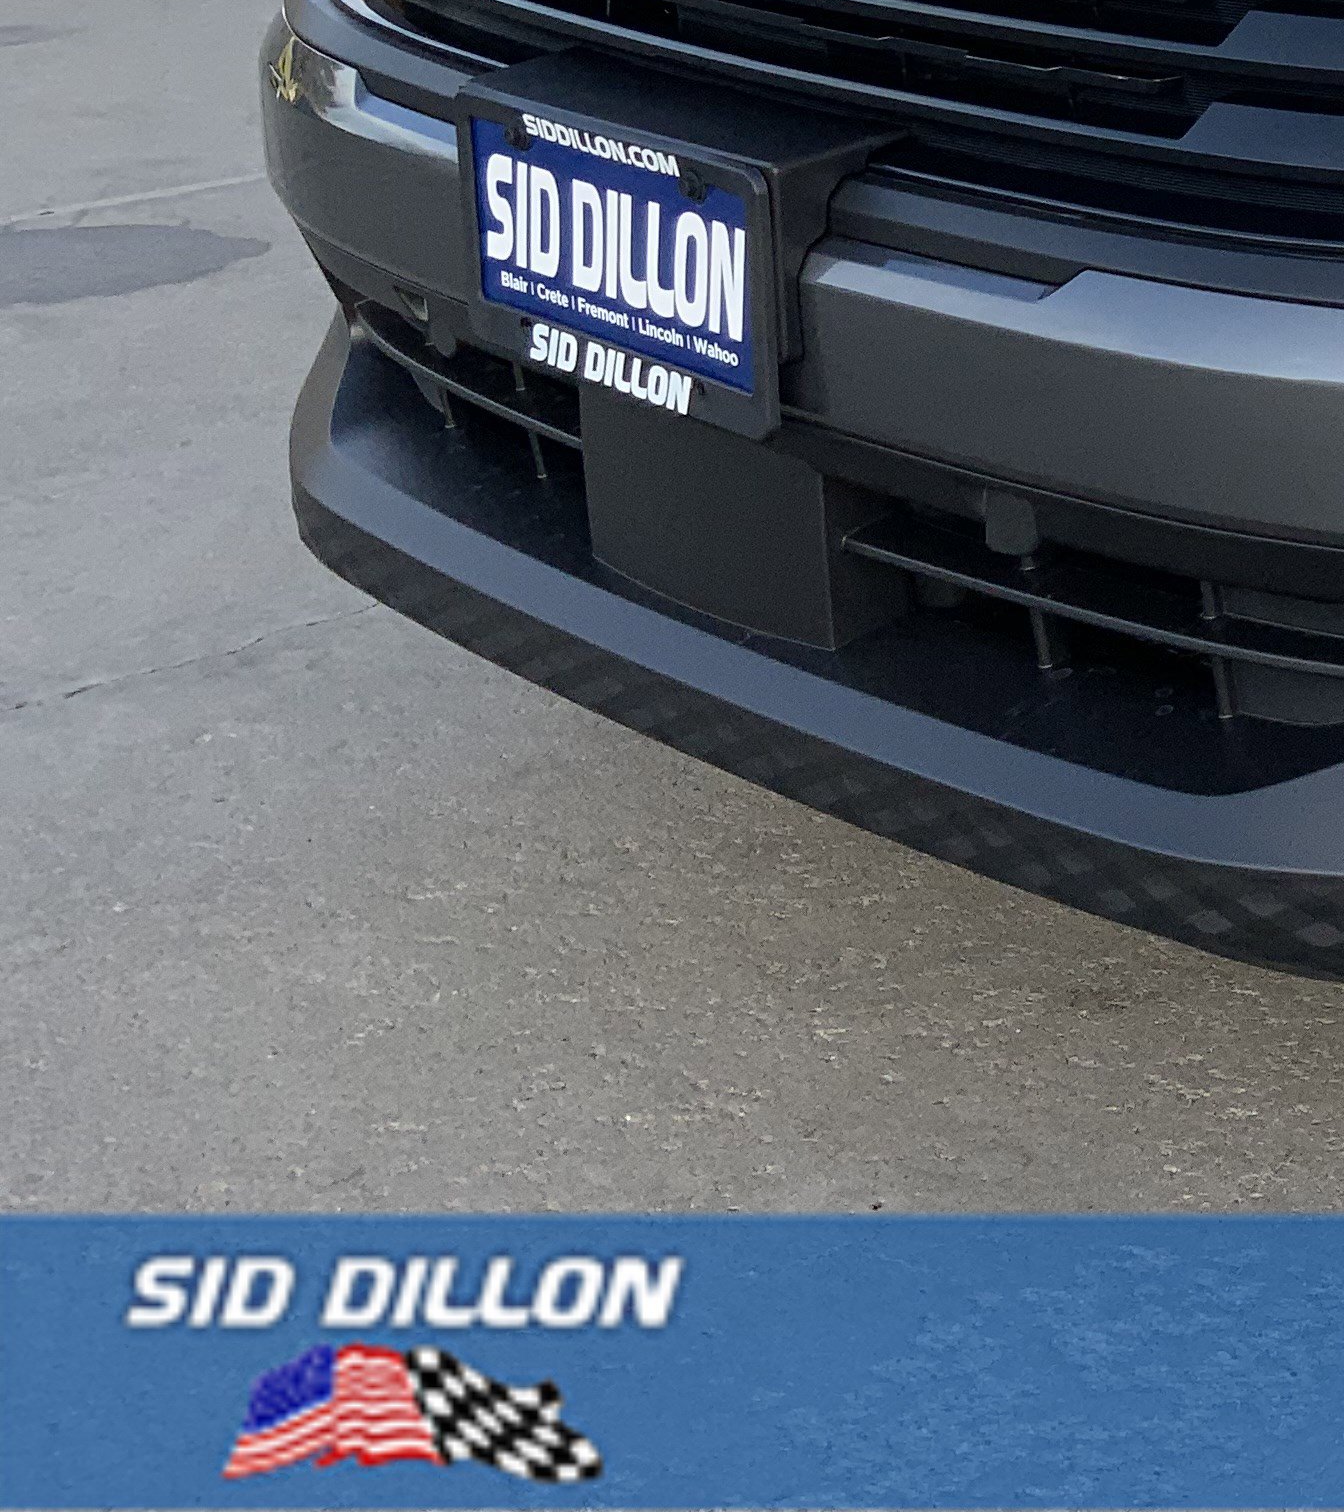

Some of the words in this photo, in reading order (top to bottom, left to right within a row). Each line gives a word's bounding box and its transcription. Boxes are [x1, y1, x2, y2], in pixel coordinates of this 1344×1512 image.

[522, 113, 680, 178] SIDDILLON.COM
[486, 153, 560, 278] SID
[572, 178, 746, 343] DILLON
[501, 270, 528, 293] Blair
[536, 283, 569, 308] Crete
[577, 296, 630, 329] Fremont
[638, 317, 684, 348] Lincoln
[693, 335, 739, 367] Wahoo
[529, 323, 578, 373] SID
[584, 342, 693, 415] DILLON
